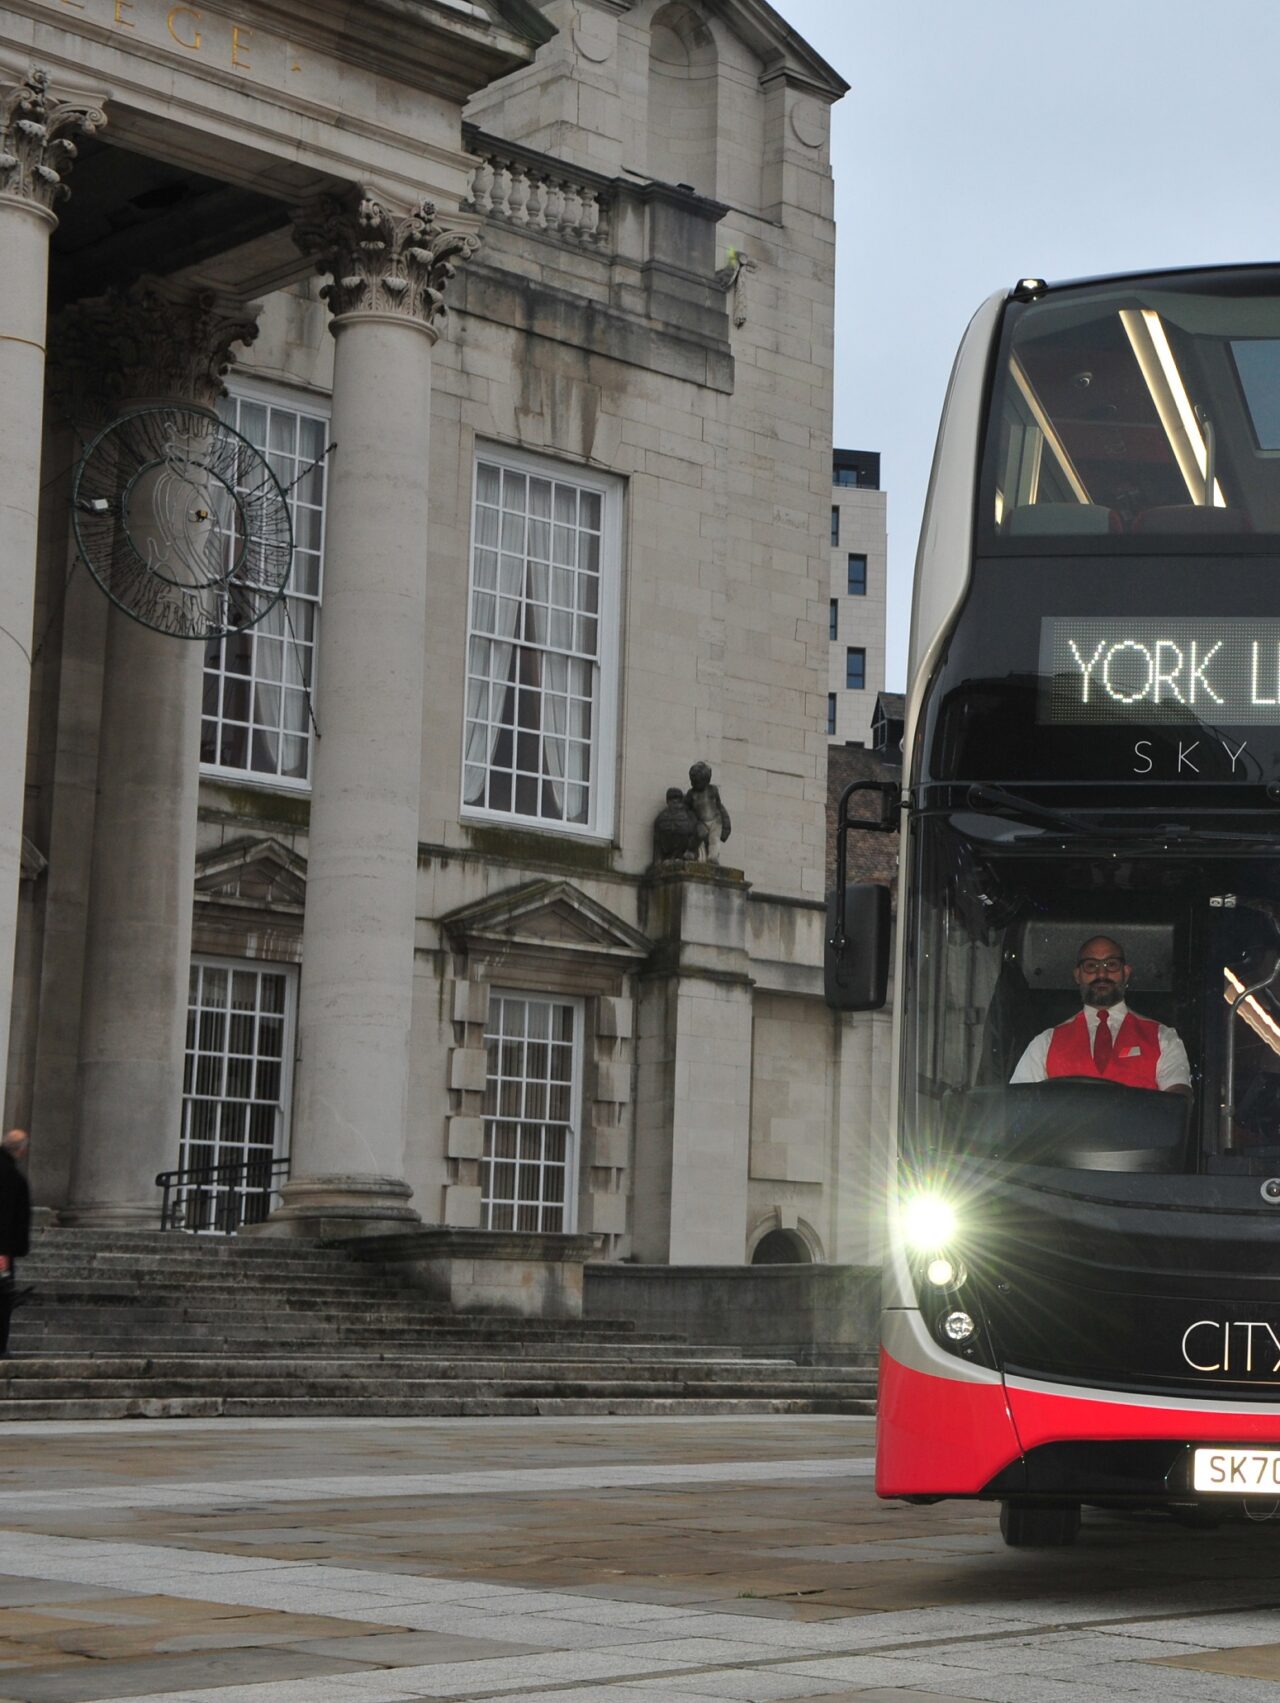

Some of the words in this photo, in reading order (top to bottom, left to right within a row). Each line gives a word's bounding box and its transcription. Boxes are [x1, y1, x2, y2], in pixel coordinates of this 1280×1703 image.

[60, 0, 251, 69] EGE
[1068, 640, 1224, 704] YORK
[1132, 741, 1249, 775] SKY
